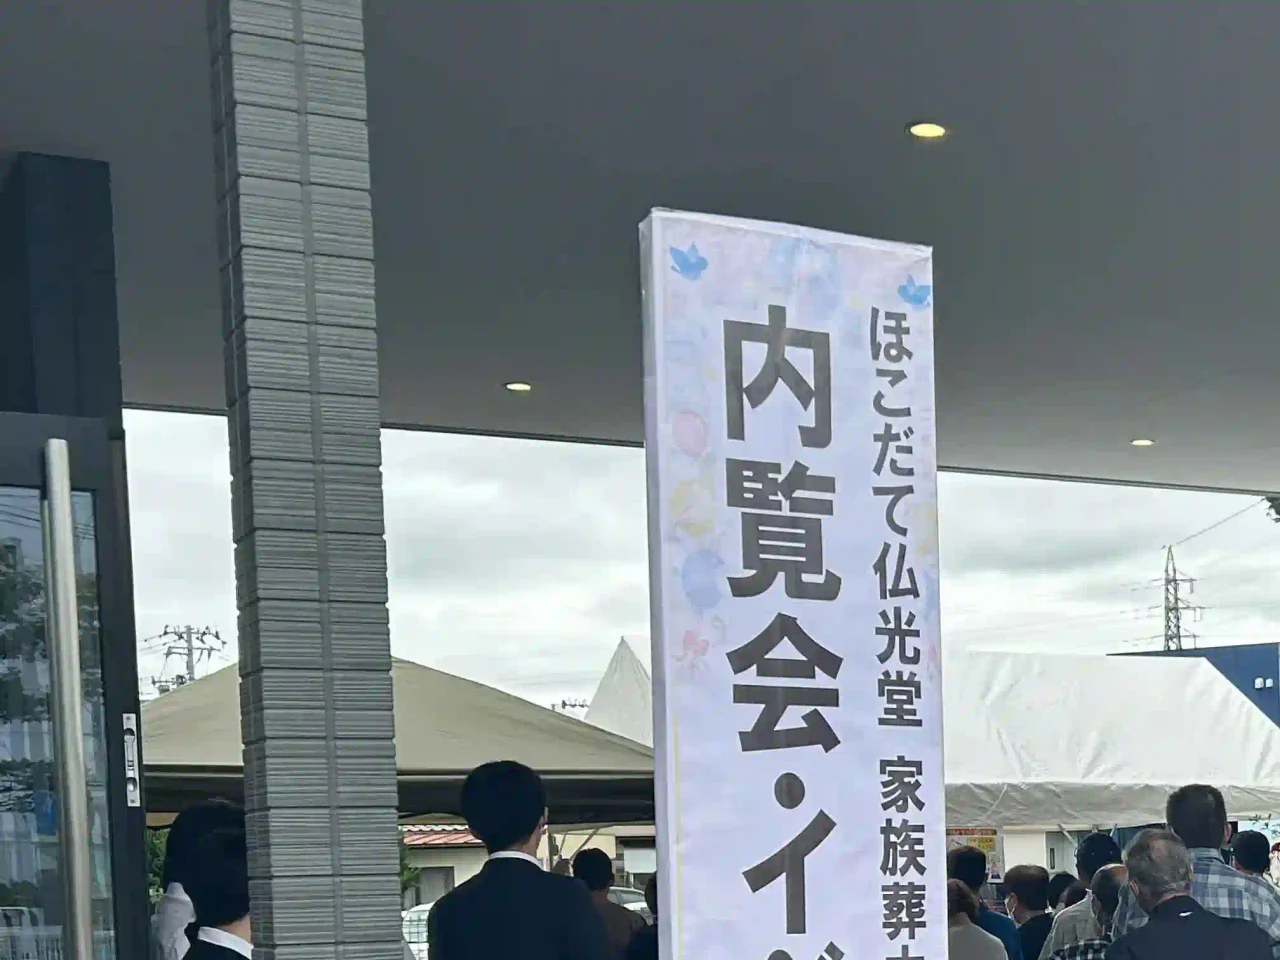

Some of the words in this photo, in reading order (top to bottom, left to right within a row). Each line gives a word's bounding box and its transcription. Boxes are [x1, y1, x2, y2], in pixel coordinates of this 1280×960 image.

[870, 306, 923, 728] ほこだて仏光堂
